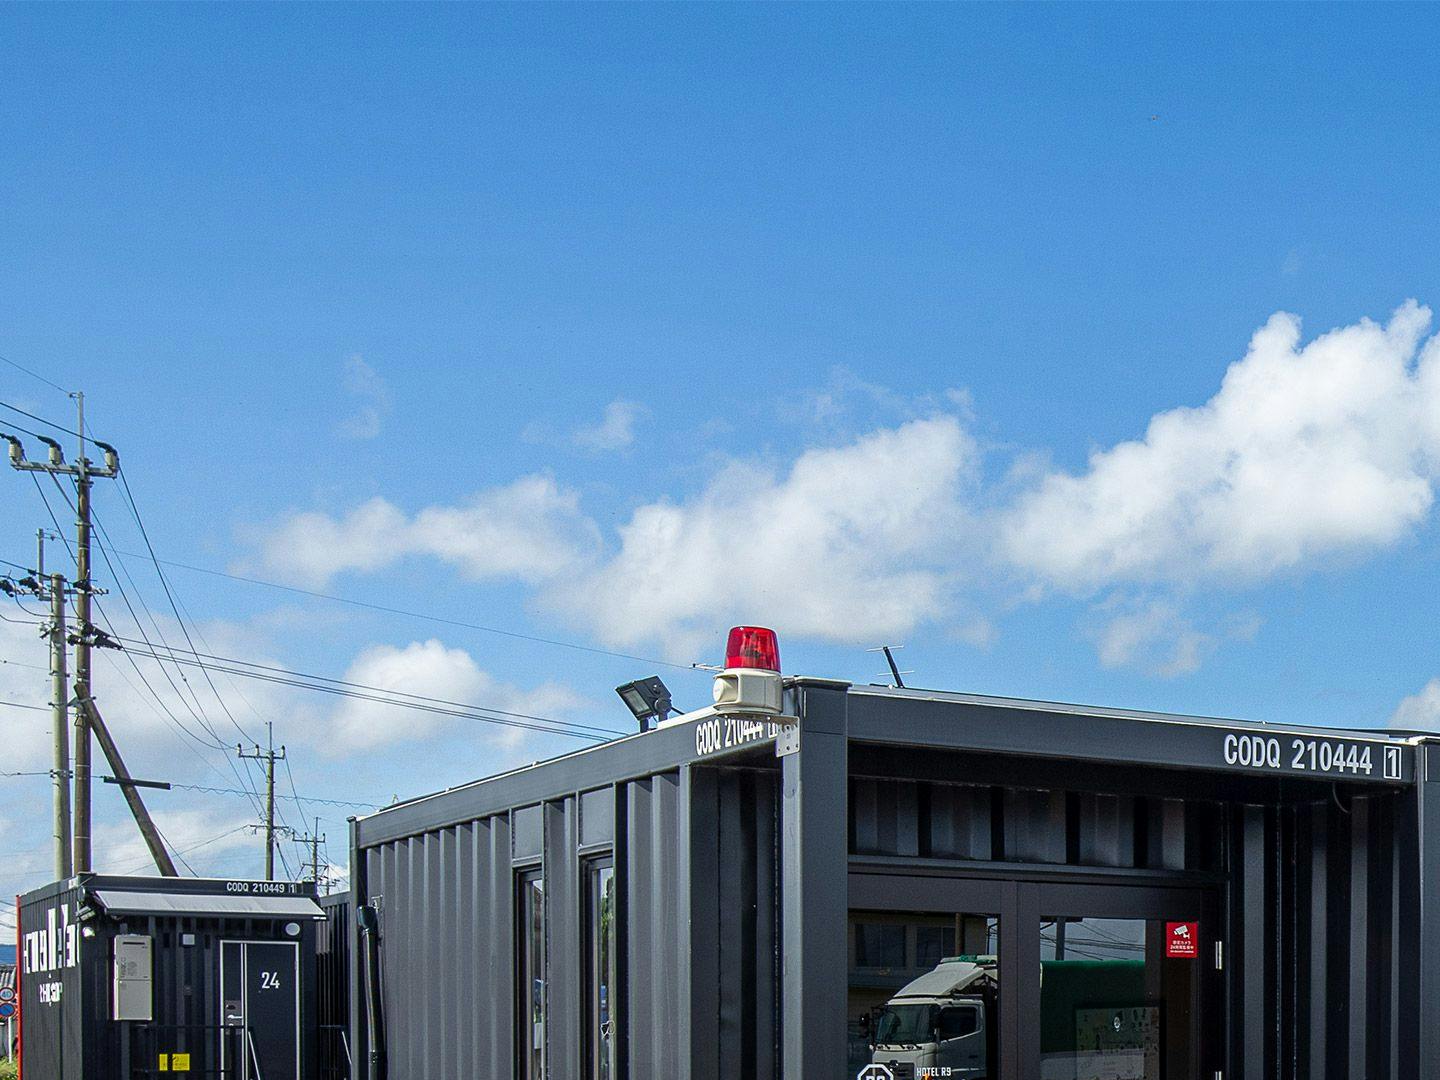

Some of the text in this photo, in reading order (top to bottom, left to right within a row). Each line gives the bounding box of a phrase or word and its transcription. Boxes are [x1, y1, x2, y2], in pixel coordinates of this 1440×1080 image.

[695, 719, 722, 756] CODQ
[1224, 734, 1399, 778] CODQ 210444 1
[226, 882, 249, 892] CODQ
[252, 883, 285, 894] 210449
[261, 971, 280, 989] 24
[916, 1066, 952, 1077] HOTEL R9
